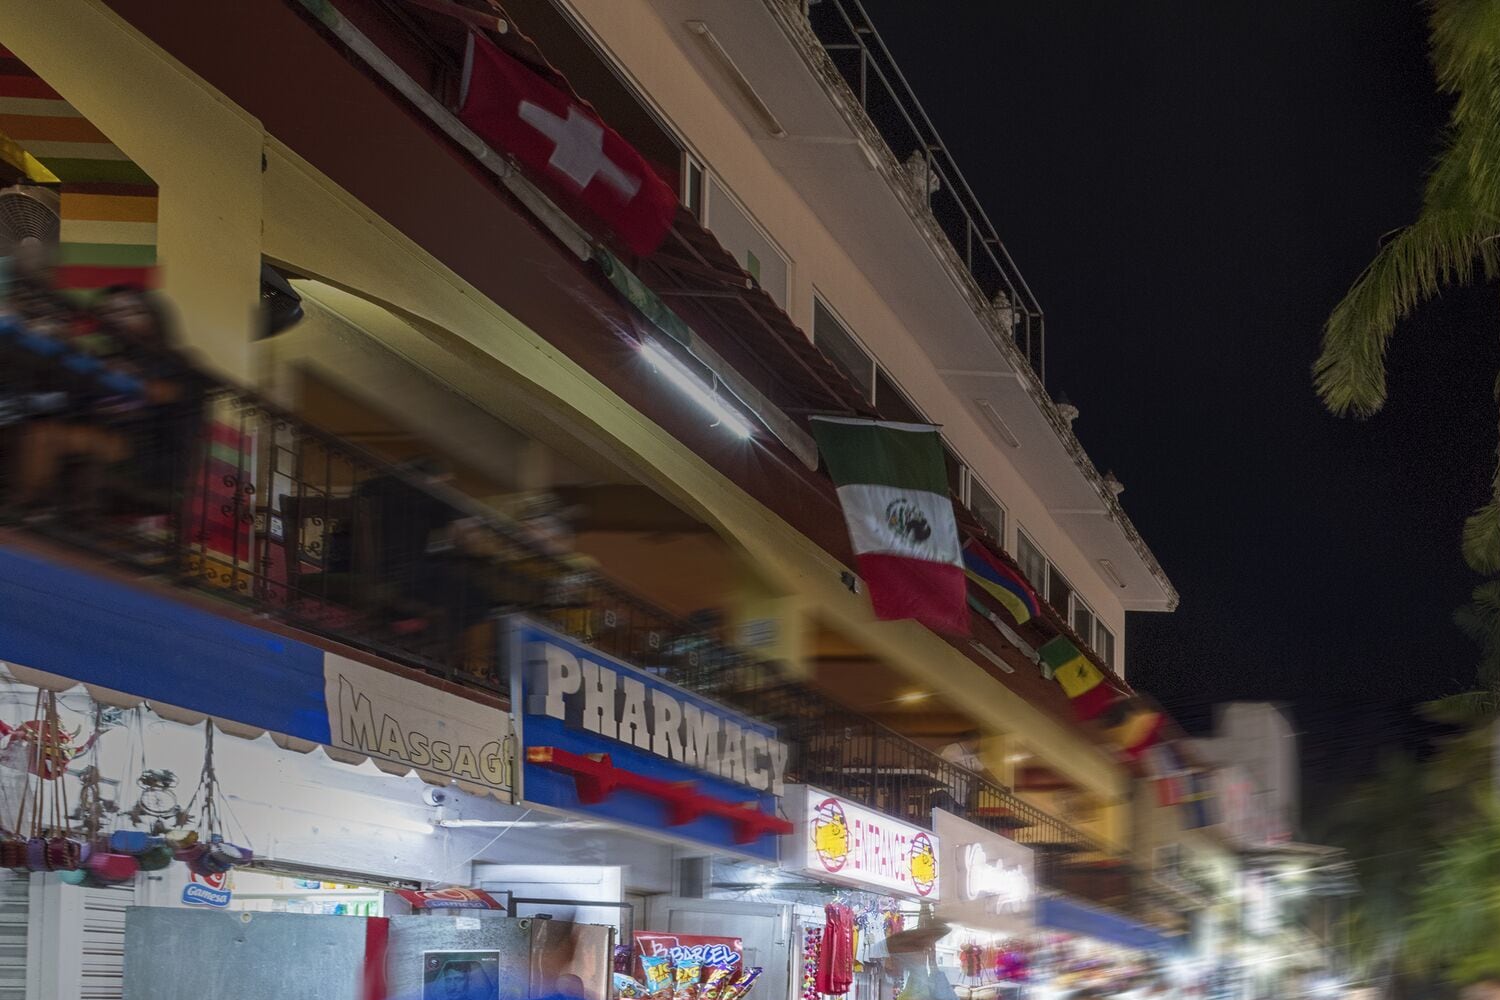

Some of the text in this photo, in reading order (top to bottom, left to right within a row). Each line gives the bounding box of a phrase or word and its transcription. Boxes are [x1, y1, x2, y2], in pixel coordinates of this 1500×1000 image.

[545, 641, 787, 797] PHARMACY
[855, 819, 906, 882] ENTRANCE
[187, 886, 228, 903] Gamesa
[670, 944, 741, 967] BARCEL
